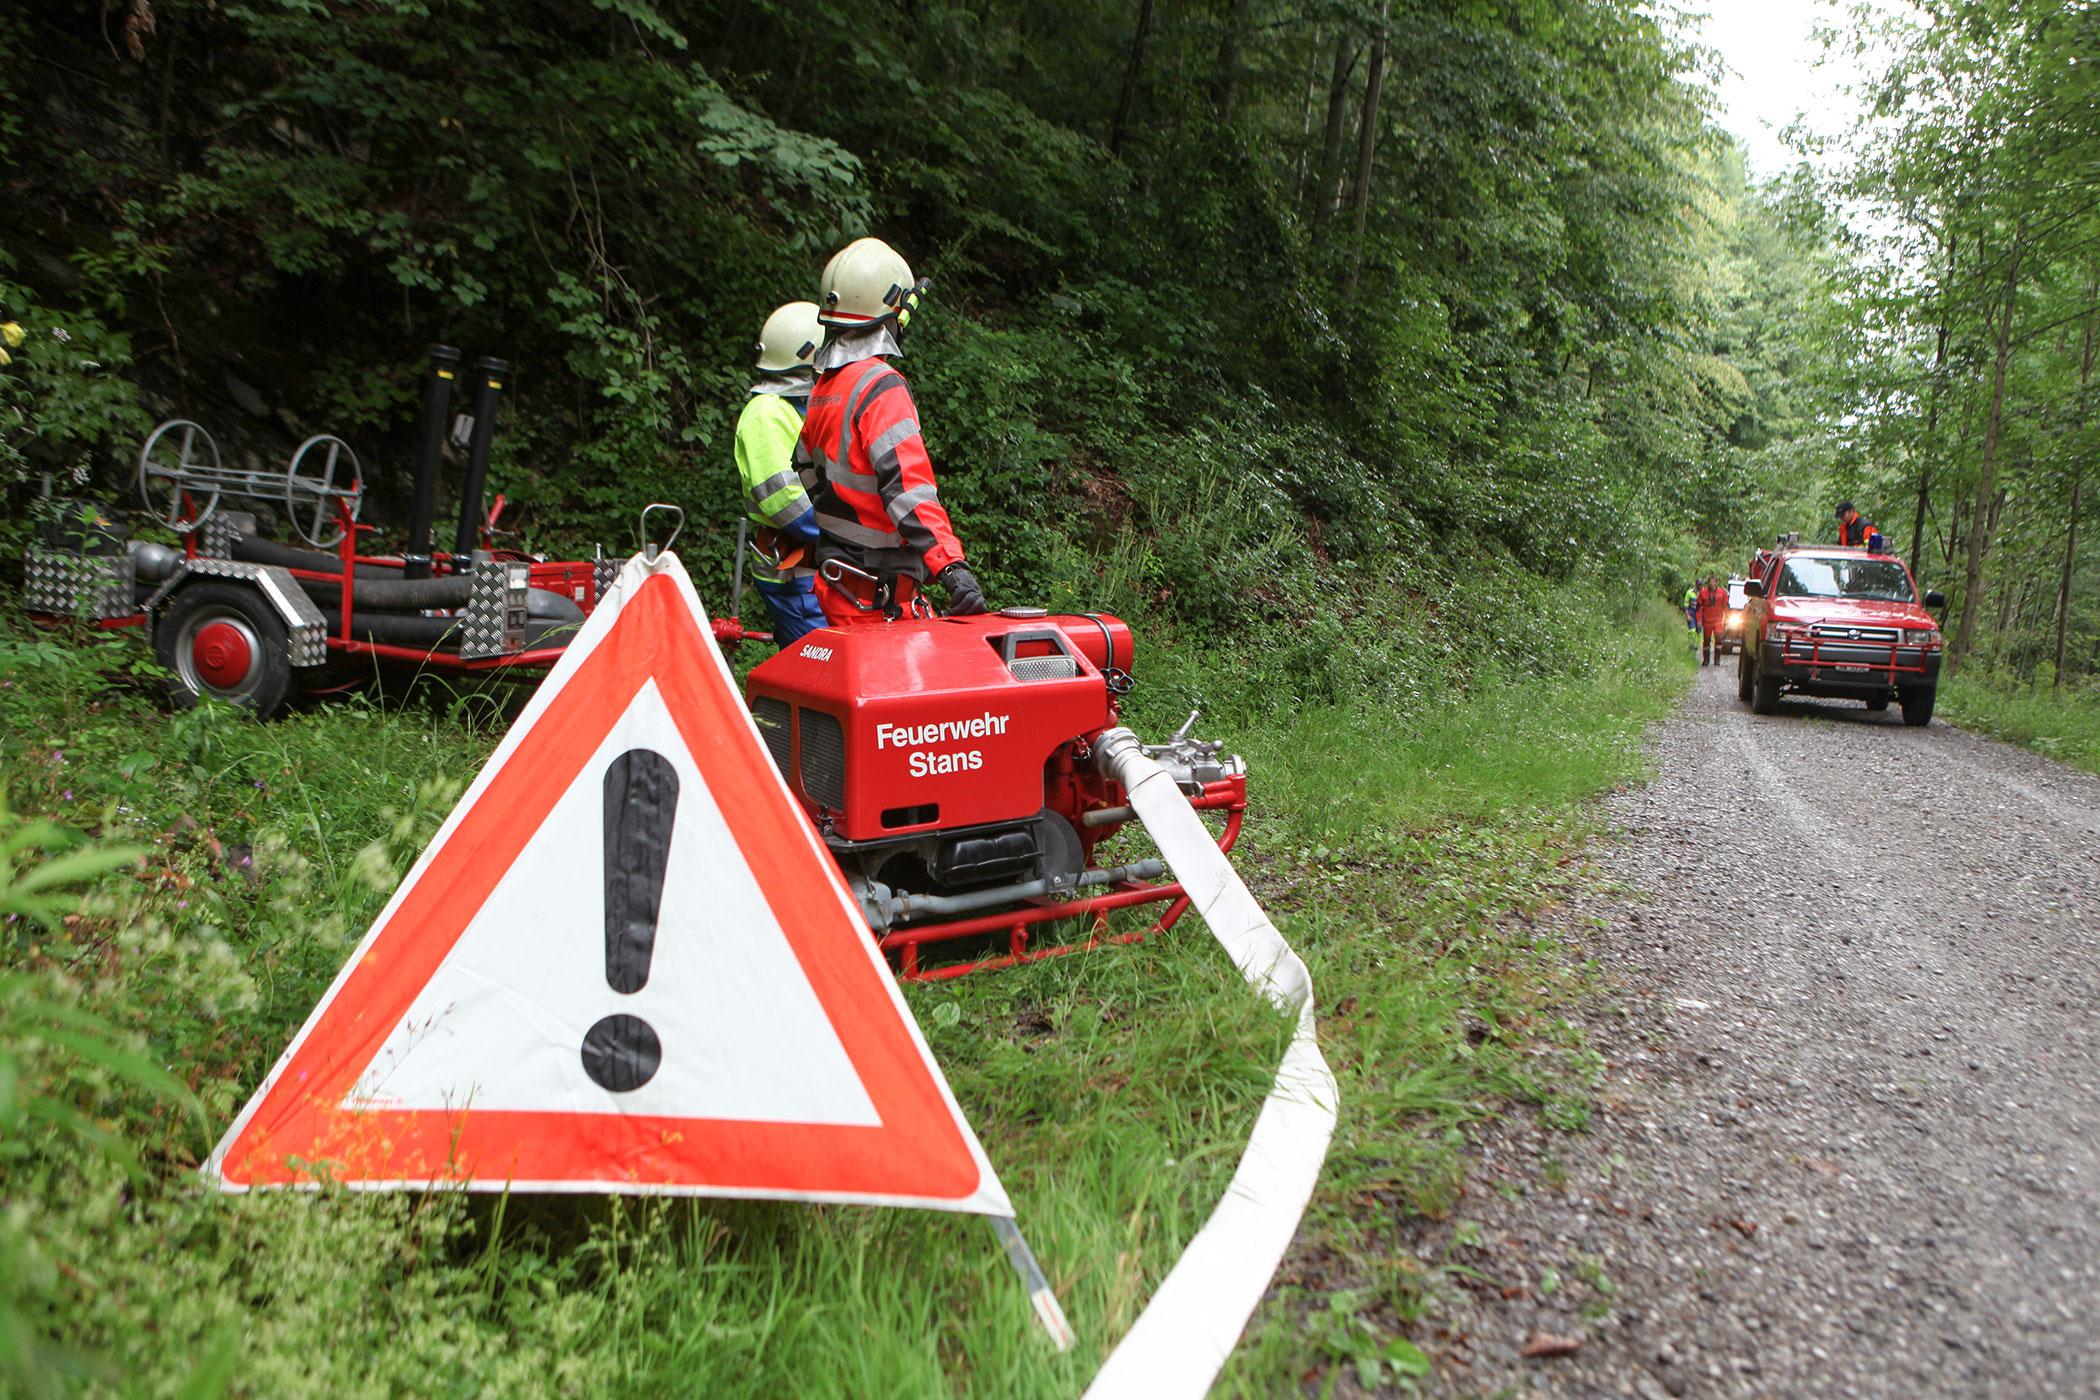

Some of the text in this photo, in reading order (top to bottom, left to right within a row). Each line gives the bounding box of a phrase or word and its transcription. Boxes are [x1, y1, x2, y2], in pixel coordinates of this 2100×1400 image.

[800, 644, 833, 662] SANDRA
[876, 711, 1010, 750] Feuerwehr
[908, 750, 983, 778] Stans
